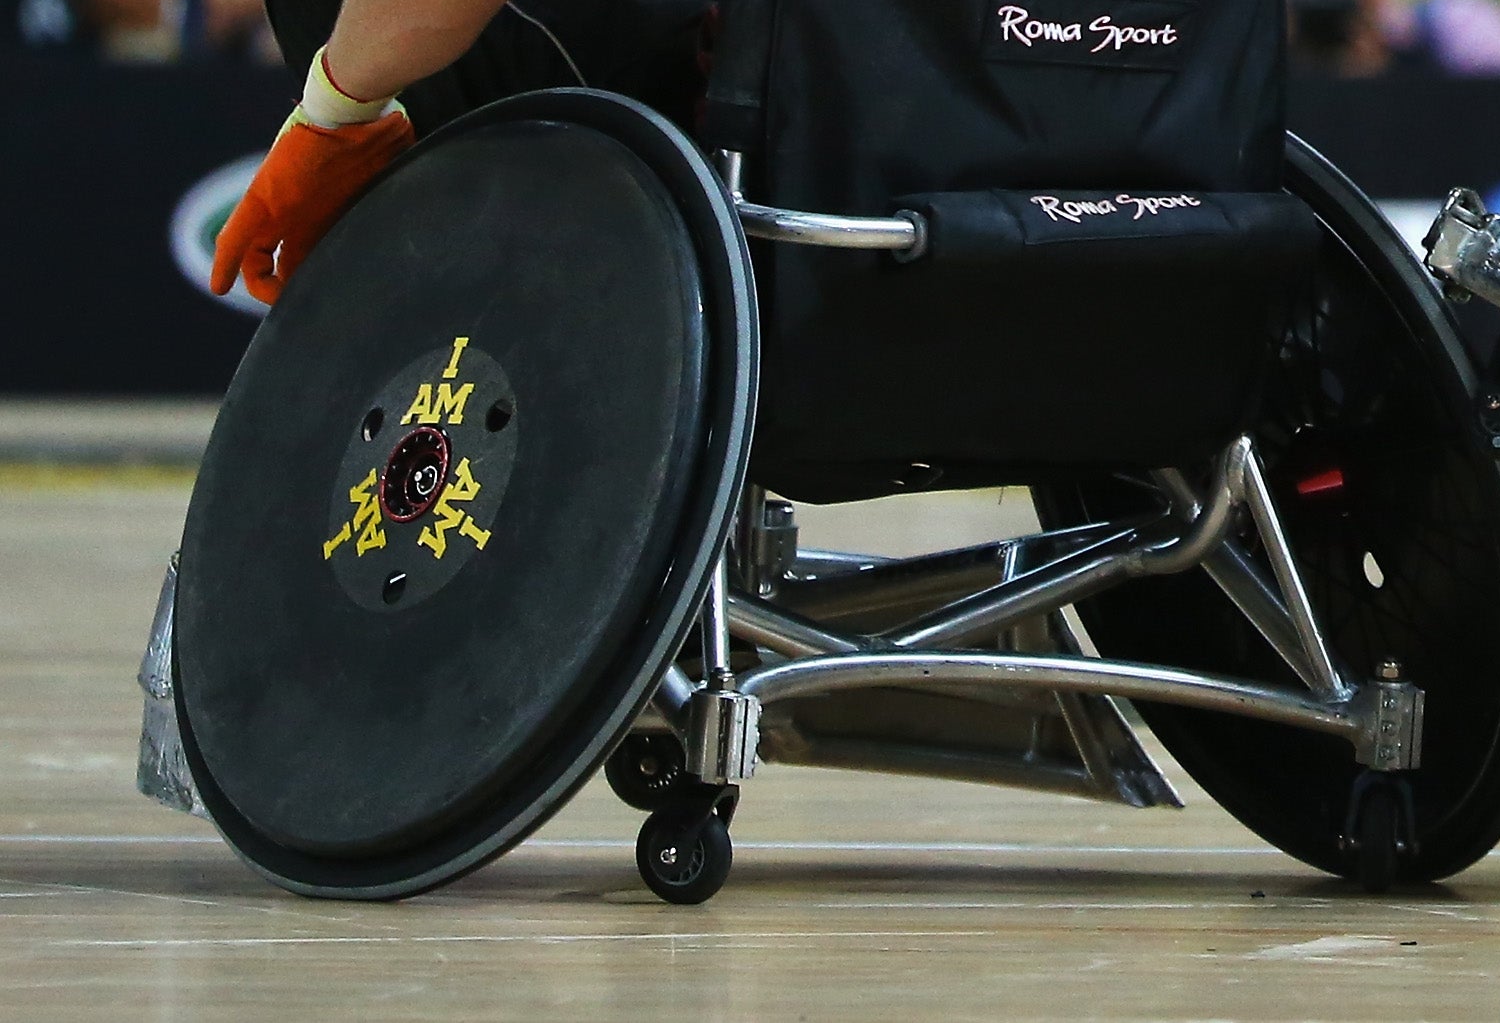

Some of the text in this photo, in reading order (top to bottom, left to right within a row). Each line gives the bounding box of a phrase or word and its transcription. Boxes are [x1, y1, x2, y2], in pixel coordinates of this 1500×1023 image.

[998, 5, 1178, 53] Roma Sport
[1030, 194, 1201, 223] Roma Sport
[442, 337, 469, 379] I
[400, 383, 475, 425] AM
